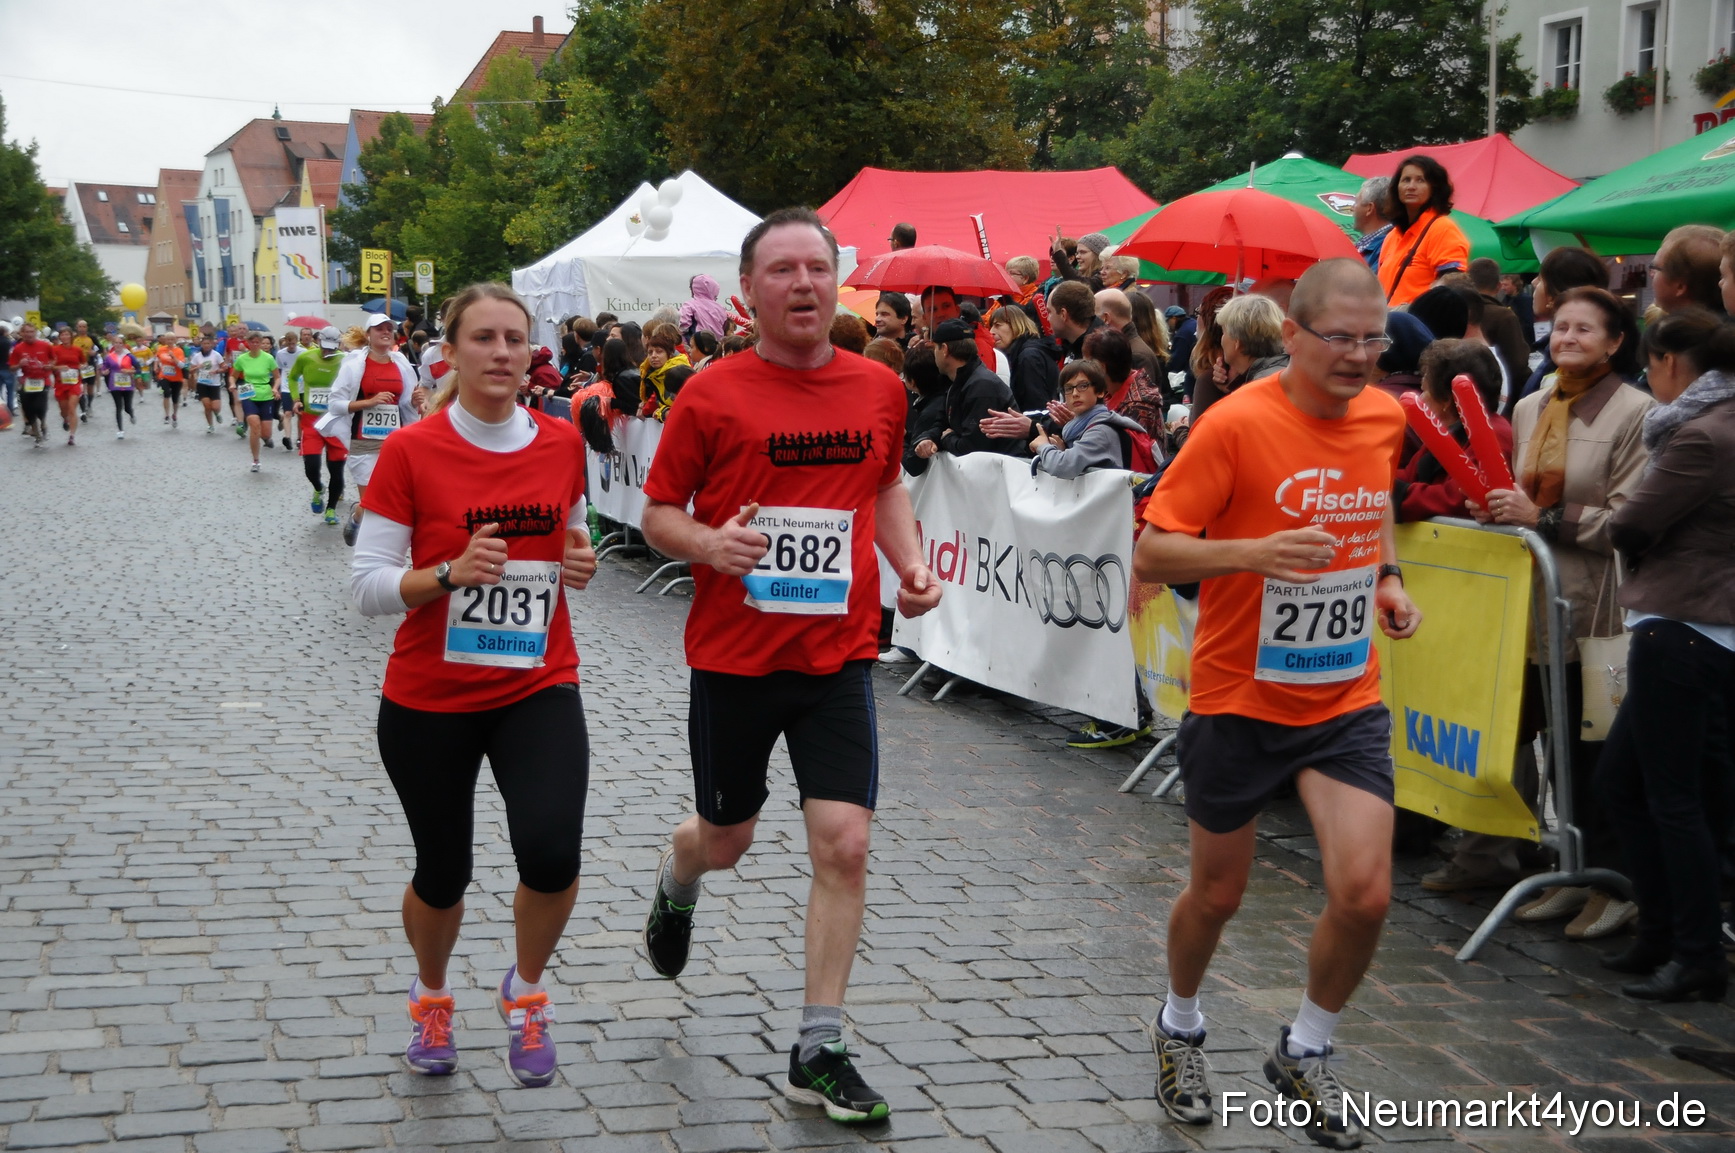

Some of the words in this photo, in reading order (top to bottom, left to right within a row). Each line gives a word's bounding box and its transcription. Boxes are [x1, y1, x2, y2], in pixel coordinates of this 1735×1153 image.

[365, 251, 388, 260] Block
[369, 263, 383, 283] B
[607, 297, 654, 312] Kinder
[367, 412, 397, 427] 2979
[775, 449, 799, 462] RUN
[802, 446, 823, 461] FOR
[825, 446, 861, 460] BÜRNI
[1301, 487, 1389, 511] Fischer
[783, 517, 834, 530] Neumarkt
[500, 572, 548, 583] Neumarkt
[770, 581, 820, 599] Günter
[1266, 584, 1309, 597] PARTL
[1311, 580, 1362, 596] Neumarkt
[461, 586, 551, 627] 2031
[1273, 594, 1367, 642] 2789
[477, 634, 536, 653] Sabrina
[1262, 637, 1269, 645] C
[1285, 651, 1353, 668] Christian
[1404, 705, 1481, 778] KANN
